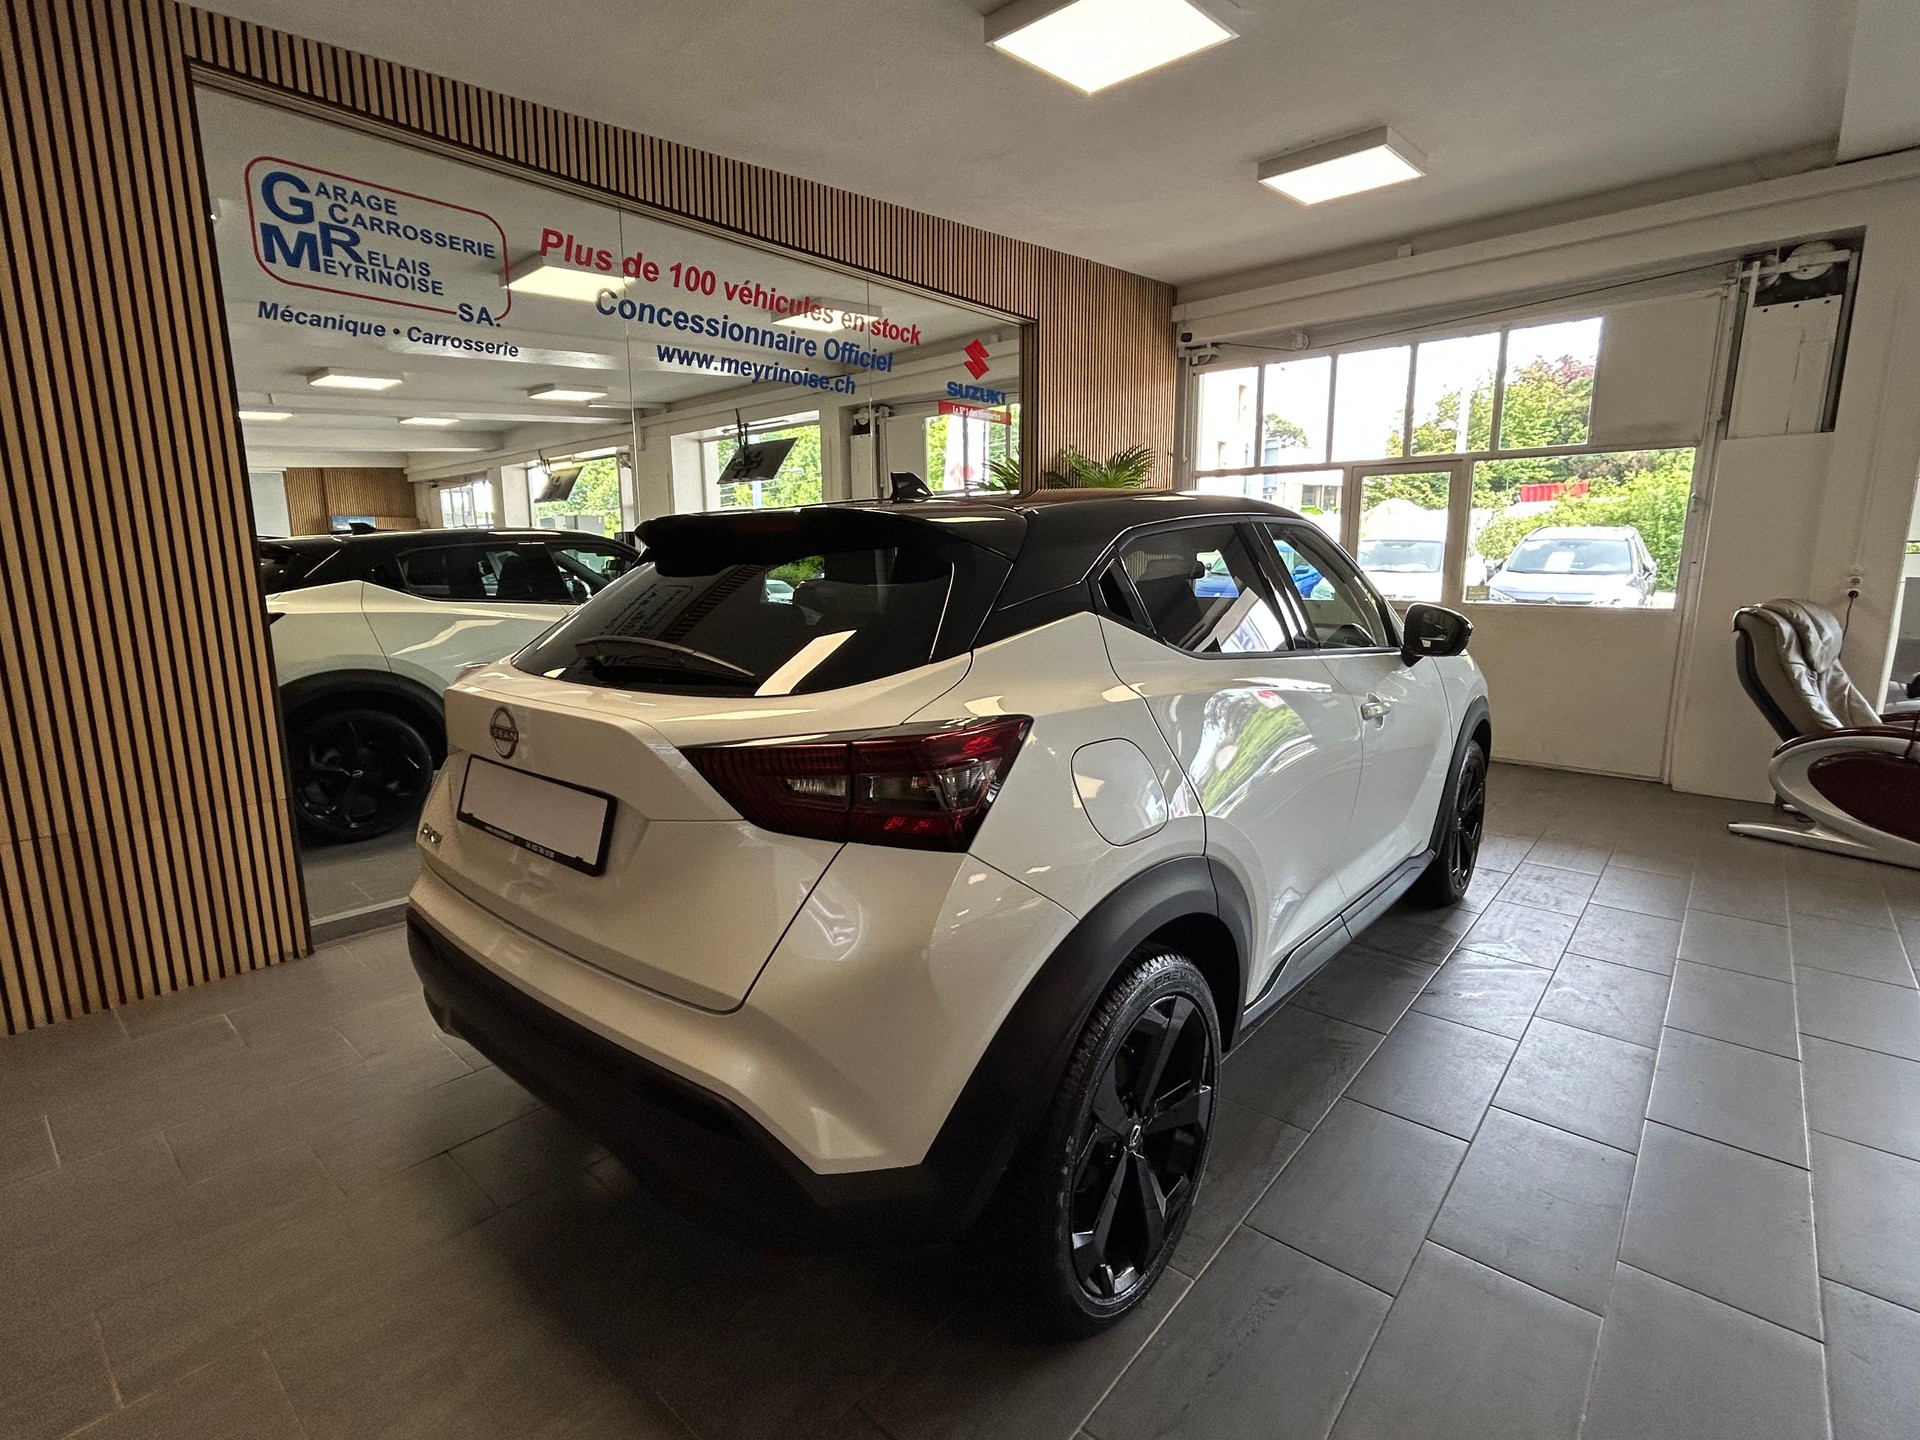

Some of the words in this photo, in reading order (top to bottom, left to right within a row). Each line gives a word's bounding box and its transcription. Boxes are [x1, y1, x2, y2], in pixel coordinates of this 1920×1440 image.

[261, 171, 398, 225] GARAGE
[260, 222, 444, 295] MEYRINOISE
[318, 220, 431, 276] RELAIS
[328, 203, 496, 259] CARROSSERIE
[540, 228, 613, 271] Plus
[623, 252, 660, 283] de
[670, 262, 716, 296] 100
[724, 280, 834, 325] véhicules
[841, 311, 865, 333] en
[869, 318, 922, 346] stock
[257, 300, 386, 338] Mécanique
[407, 326, 519, 358] Carrosserie
[595, 288, 817, 358] Concessionnaire
[824, 337, 894, 373] Officiel
[656, 344, 856, 395] www.meyrinoise.ch
[947, 381, 1006, 405] SUZUKI
[490, 726, 518, 742] SSAN
